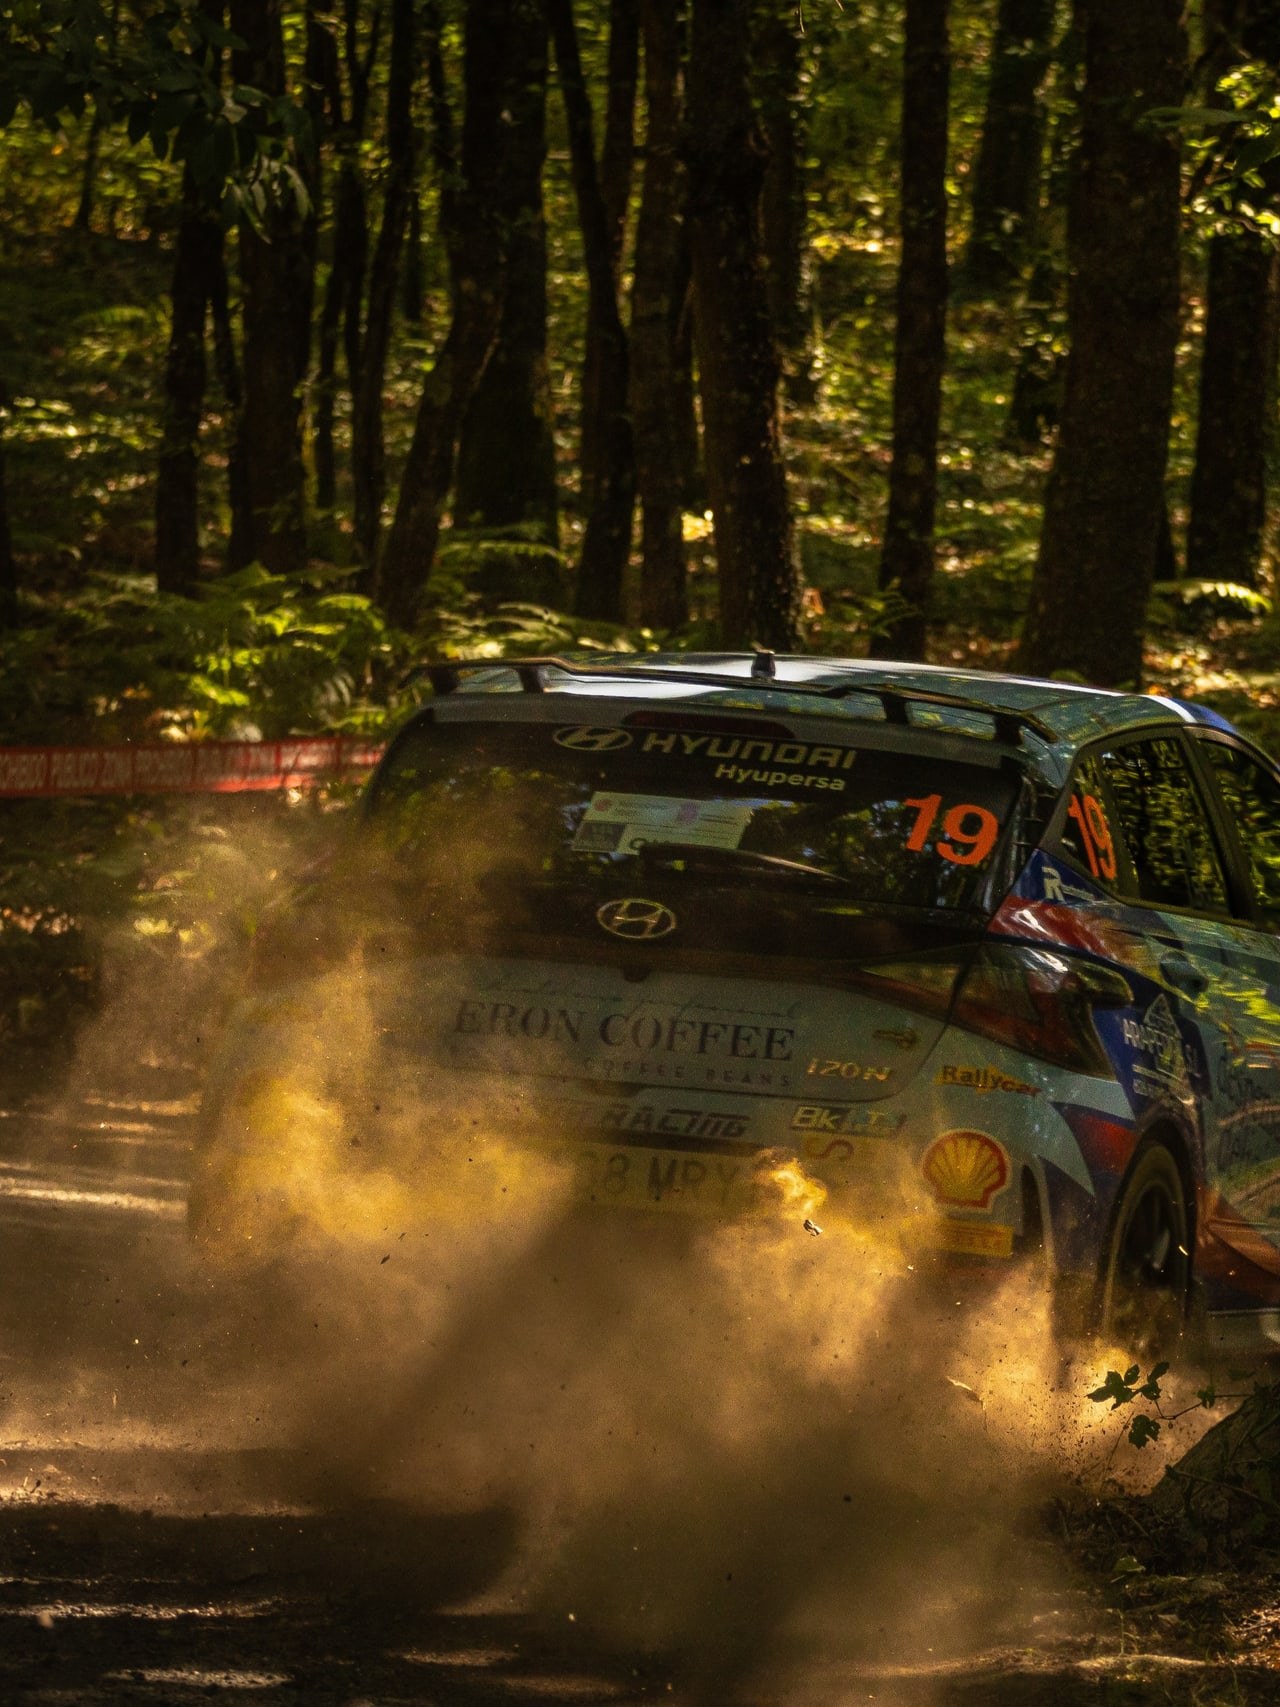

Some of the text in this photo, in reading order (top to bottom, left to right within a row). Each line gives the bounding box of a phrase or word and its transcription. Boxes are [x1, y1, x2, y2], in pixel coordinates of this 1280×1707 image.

[643, 730, 858, 770] HYUNDAI
[715, 762, 847, 792] Hyupersa
[902, 792, 999, 866] 19
[1067, 793, 1118, 881] 19
[600, 1012, 795, 1062] COFFEE
[705, 1067, 792, 1088] BEANS
